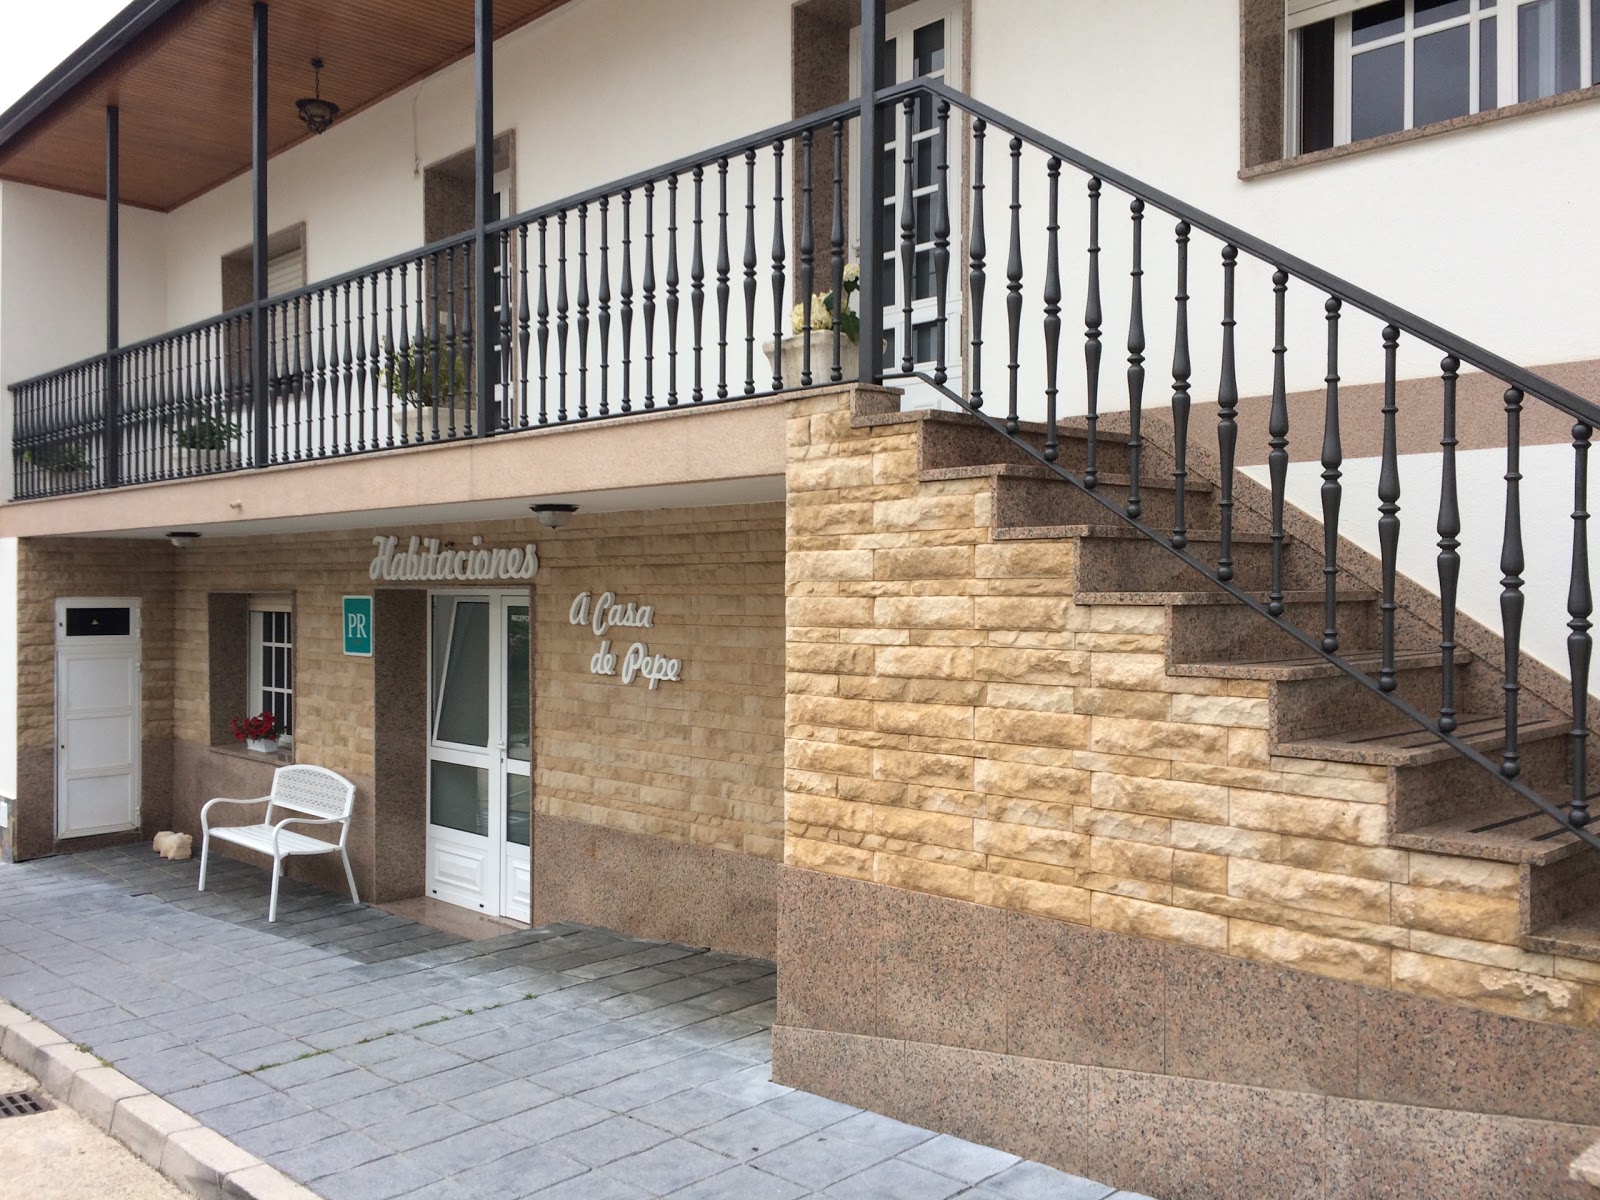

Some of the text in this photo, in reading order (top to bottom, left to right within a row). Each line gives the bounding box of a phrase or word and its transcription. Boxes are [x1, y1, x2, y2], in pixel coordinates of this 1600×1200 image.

[369, 536, 538, 580] Habitaciones
[347, 613, 367, 638] PR
[592, 591, 655, 635] Casa
[590, 640, 682, 690] de Pepe
